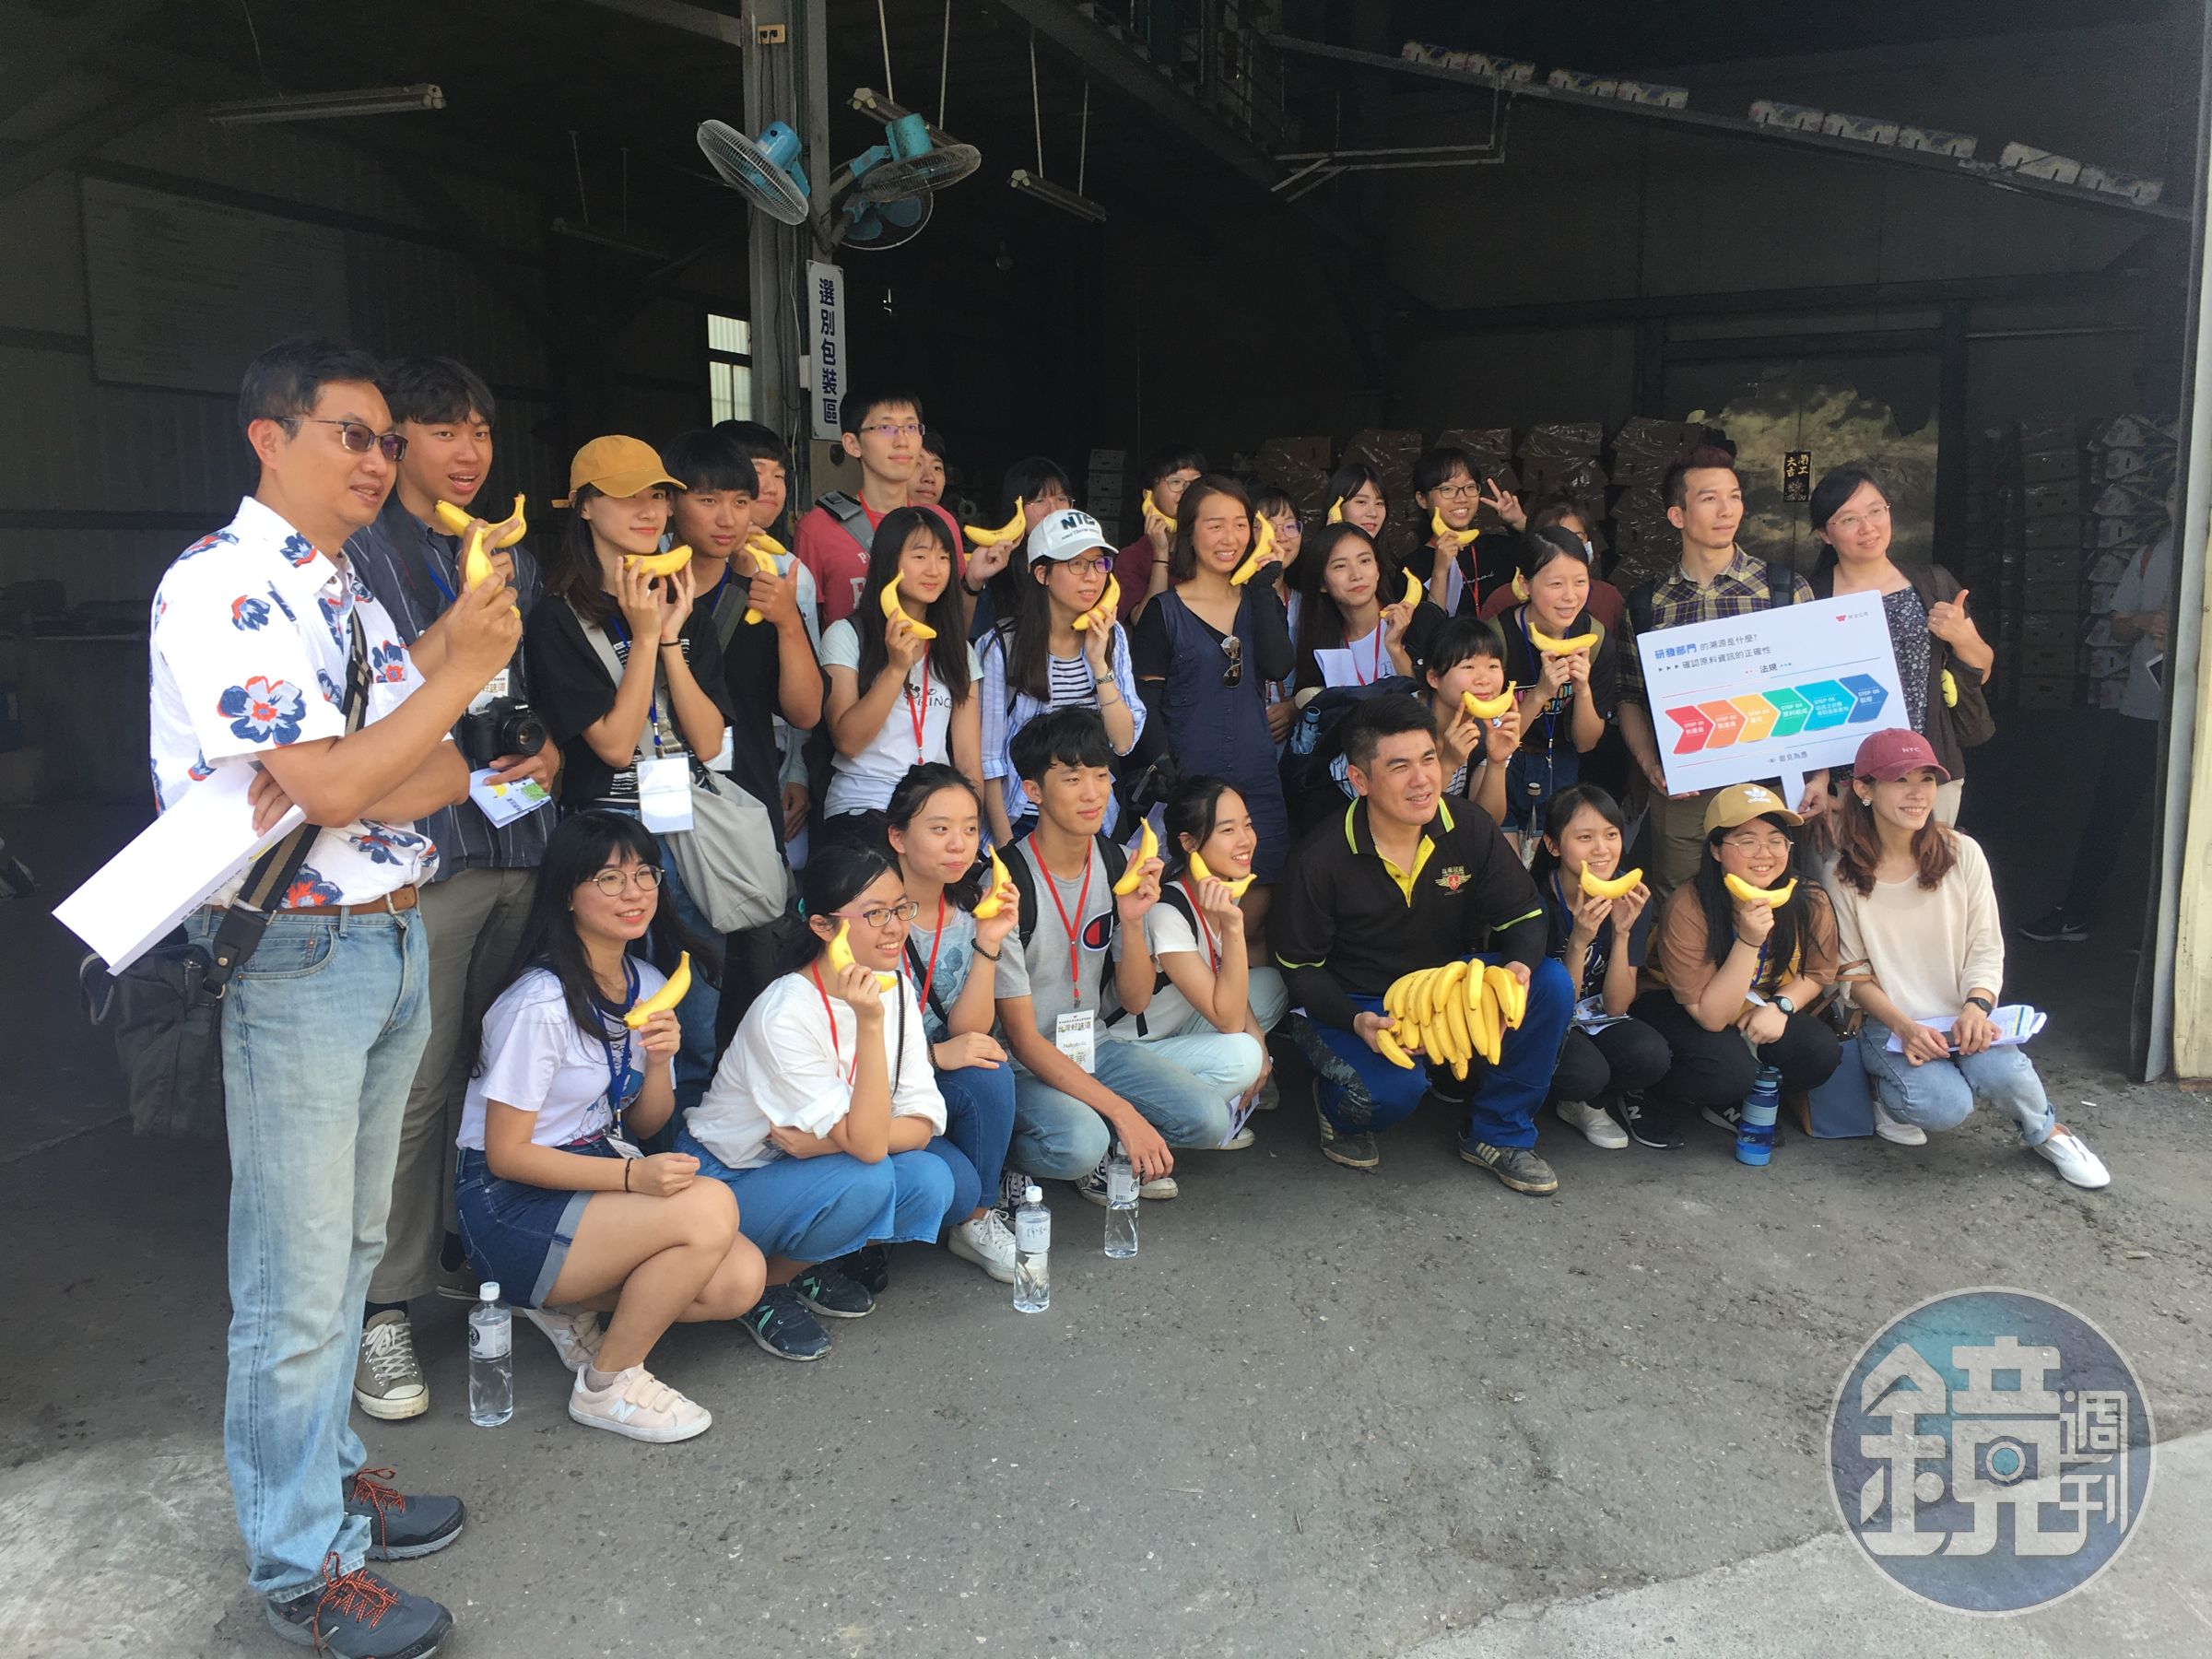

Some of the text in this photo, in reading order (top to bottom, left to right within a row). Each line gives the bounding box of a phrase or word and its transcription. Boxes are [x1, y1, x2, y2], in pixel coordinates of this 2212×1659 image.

[819, 277, 838, 424] 選別包裝區
[1786, 456, 1797, 477] 大吉
[1654, 643, 1697, 659] 研發部門
[1682, 646, 1771, 669] 確認原料資訊的正確性
[1760, 663, 1778, 674] 法規
